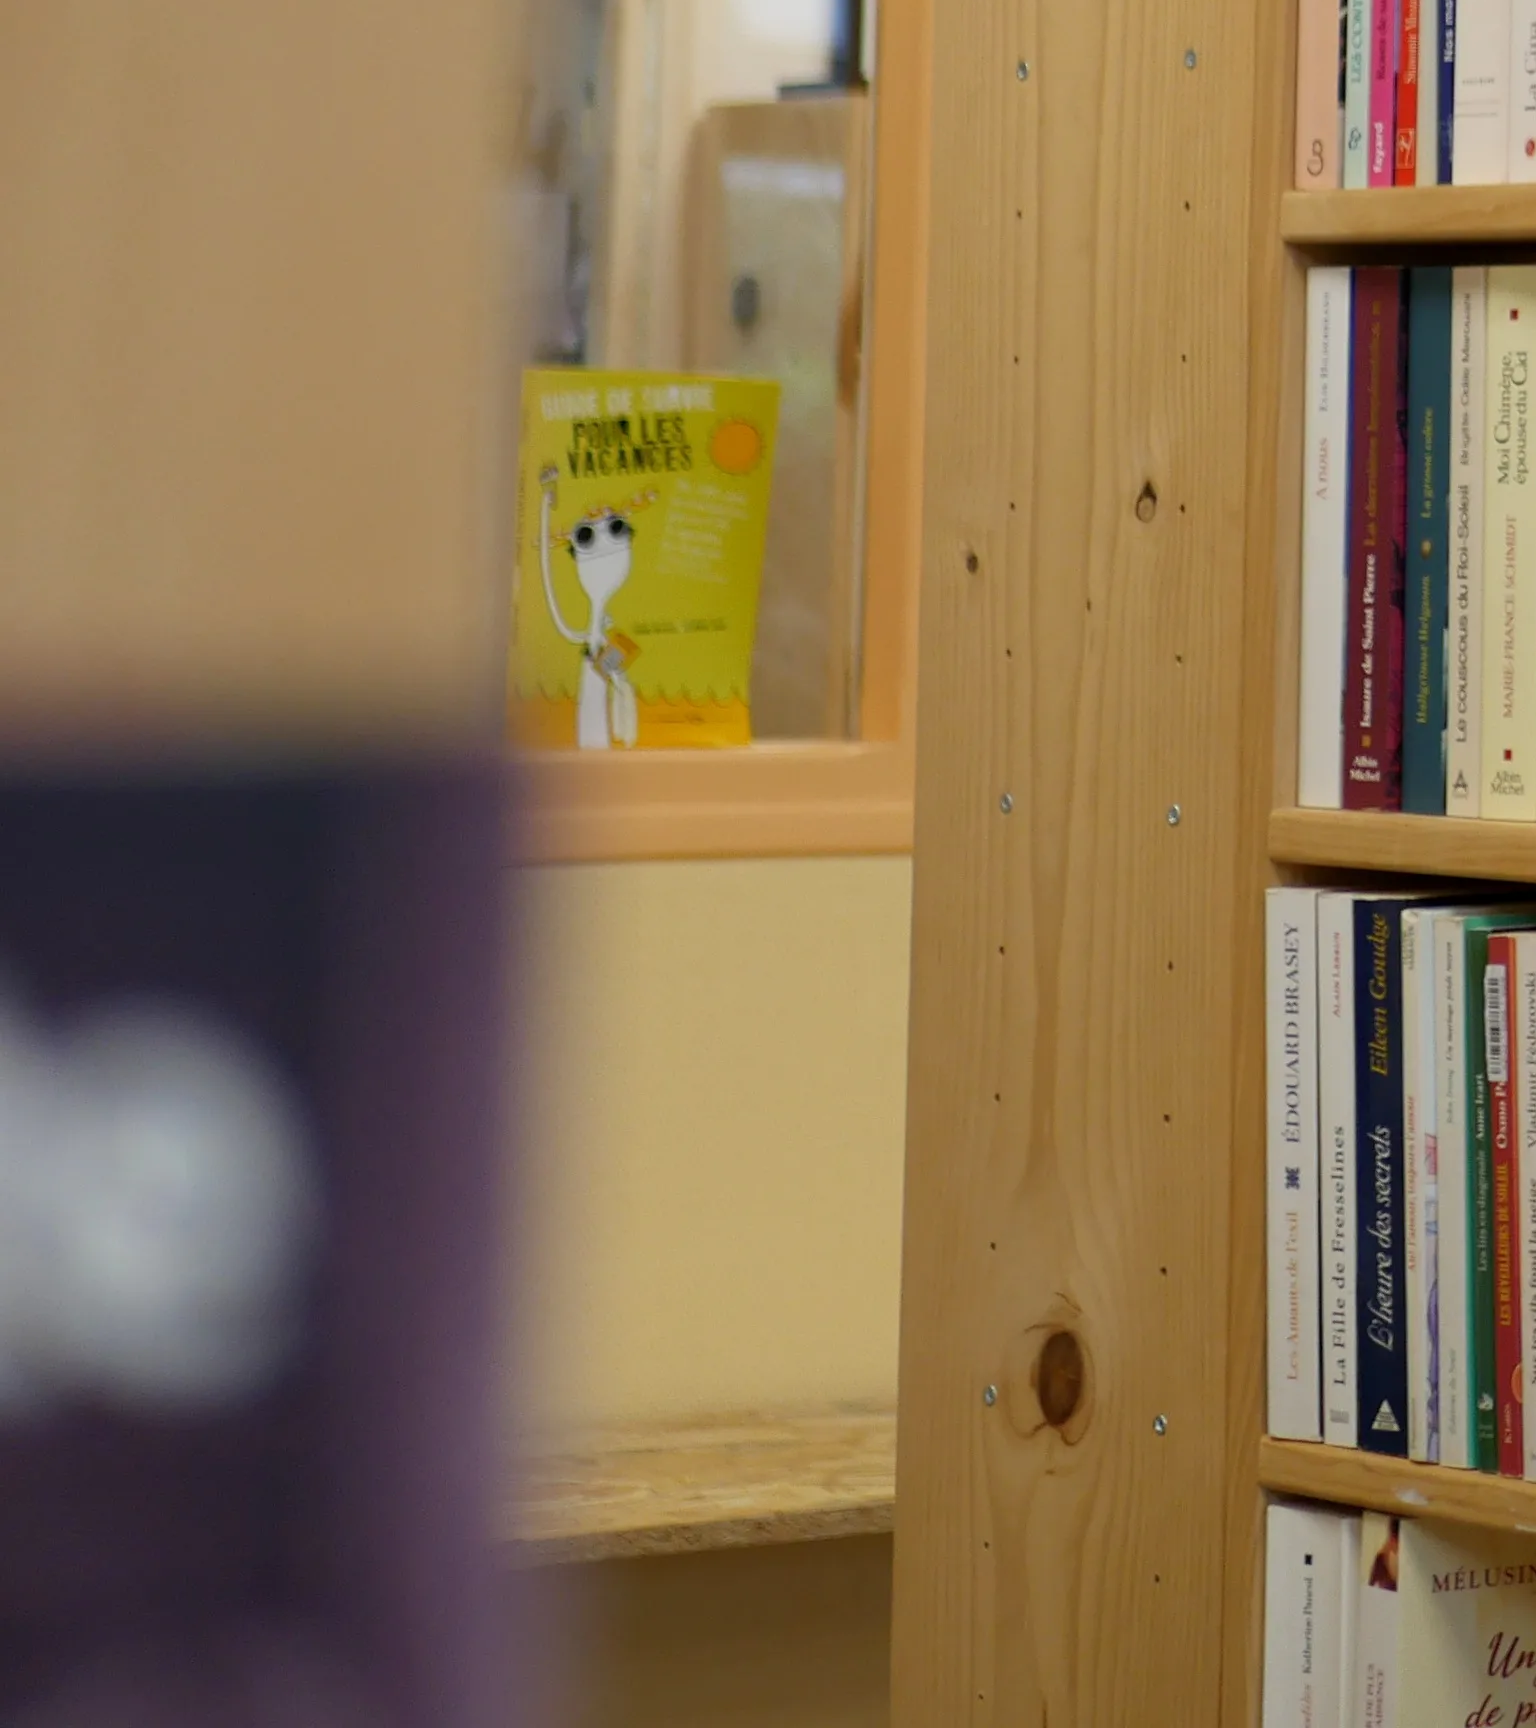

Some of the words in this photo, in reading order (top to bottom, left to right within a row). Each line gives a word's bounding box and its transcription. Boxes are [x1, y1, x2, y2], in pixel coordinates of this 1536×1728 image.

[567, 445, 694, 479] VACANCES
[1285, 923, 1300, 1015] BRASEY
[1369, 913, 1387, 1001] Goudge
[1370, 1007, 1387, 1076] Eileen
[1282, 1022, 1300, 1145] ÉDOUARD
[1370, 1126, 1393, 1202] secrets
[1371, 1207, 1392, 1250] des
[1367, 1254, 1393, 1351] L'heure
